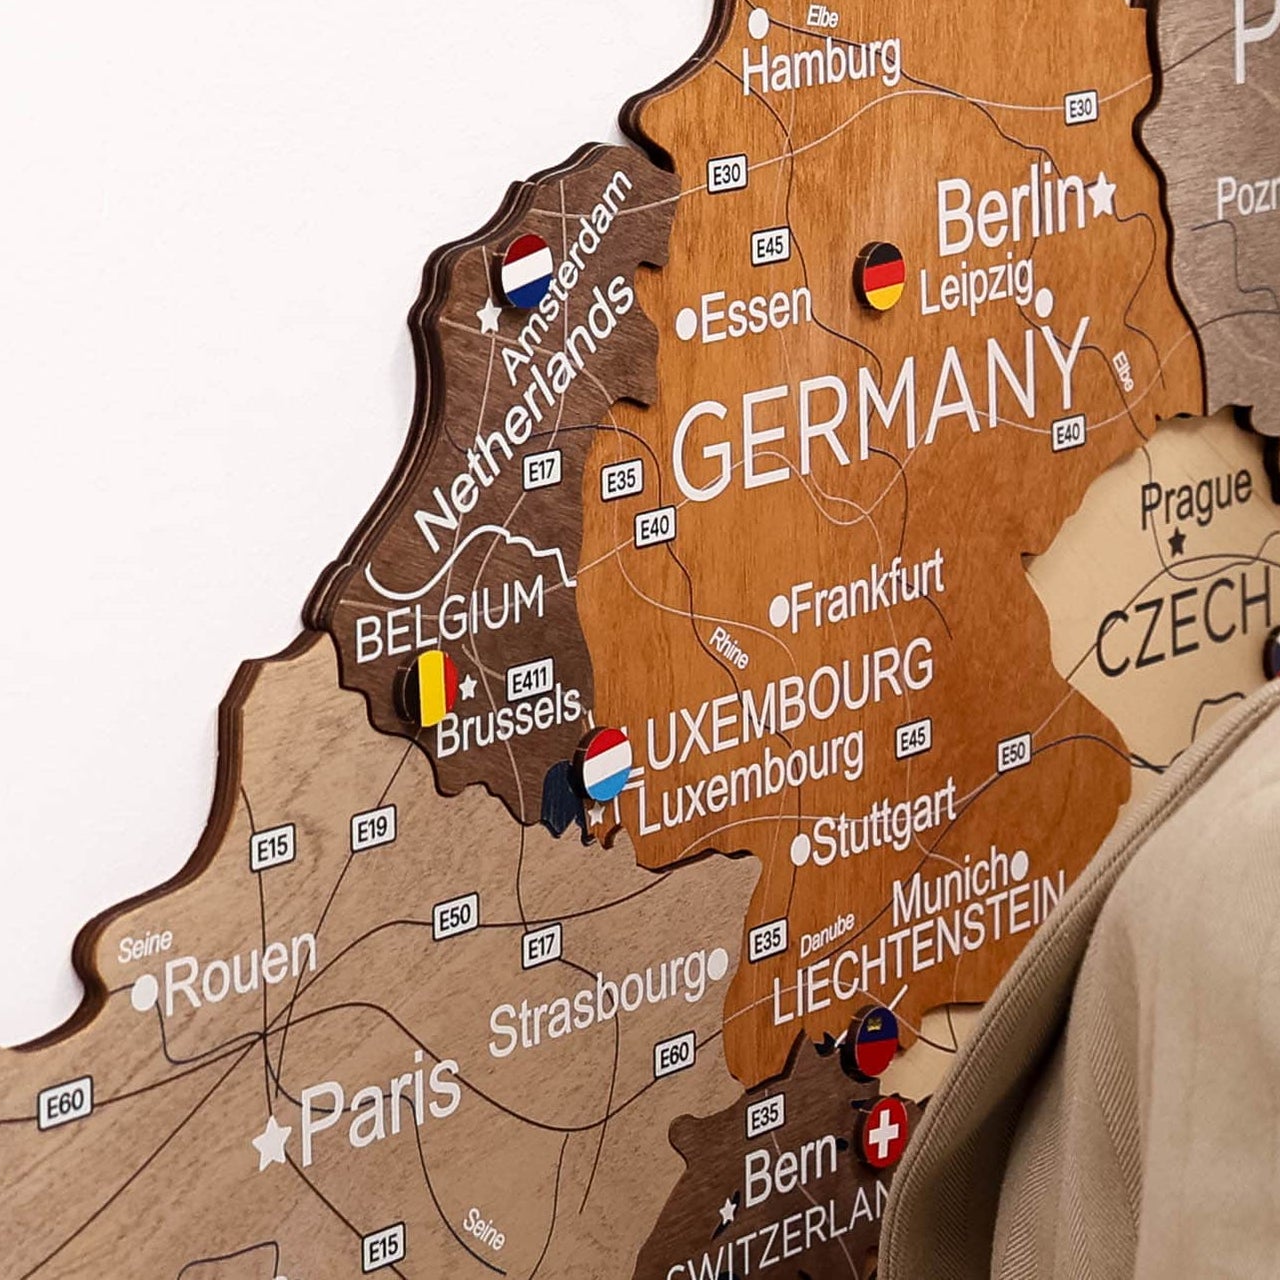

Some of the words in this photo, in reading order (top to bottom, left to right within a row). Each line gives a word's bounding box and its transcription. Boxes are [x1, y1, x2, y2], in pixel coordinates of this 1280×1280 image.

[806, 3, 838, 28] Elbe
[742, 33, 902, 96] Hamburg
[1069, 97, 1093, 119] E30
[713, 163, 741, 186] E30
[938, 160, 1086, 258] Berlin
[756, 235, 785, 259] E45
[500, 168, 633, 387] Amsterdam
[921, 251, 1035, 320] Leipzig
[701, 285, 812, 345] Essen
[1112, 349, 1136, 394] Elbe
[413, 274, 635, 554] Netherlands
[672, 316, 1090, 503] GERMANY
[1056, 421, 1081, 446] E40
[528, 457, 556, 482] E17
[607, 466, 636, 491] E35
[1141, 468, 1253, 531] Prague
[639, 514, 670, 539] E40
[791, 547, 945, 634] Frankfurt
[355, 573, 545, 664] BELGIUM
[1095, 565, 1271, 678] CZECH
[709, 625, 751, 671] Rhine
[511, 666, 548, 695] E411
[436, 683, 582, 759] Brussels
[900, 726, 927, 754] E45
[1001, 740, 1027, 765] E50
[639, 729, 865, 836] Luxembourg
[357, 816, 389, 845] E19
[813, 776, 958, 867] Stuttgart
[256, 834, 289, 863] E15
[893, 844, 1010, 927] Munich
[438, 903, 472, 930] E50
[754, 925, 782, 953] E35
[800, 909, 856, 959] Danube
[118, 929, 174, 964] Seine
[527, 933, 557, 962] E17
[773, 869, 1065, 1026] LIECHTENSTEIN
[165, 931, 318, 1018] Rouen
[489, 946, 707, 1060] Strasbourg
[660, 1040, 690, 1065] E60
[46, 1087, 86, 1122] E60
[301, 1049, 462, 1169] Paris
[752, 1100, 780, 1129] E35
[744, 1132, 838, 1209] Bern
[368, 1233, 399, 1264] E15
[463, 1206, 507, 1252] Seine
